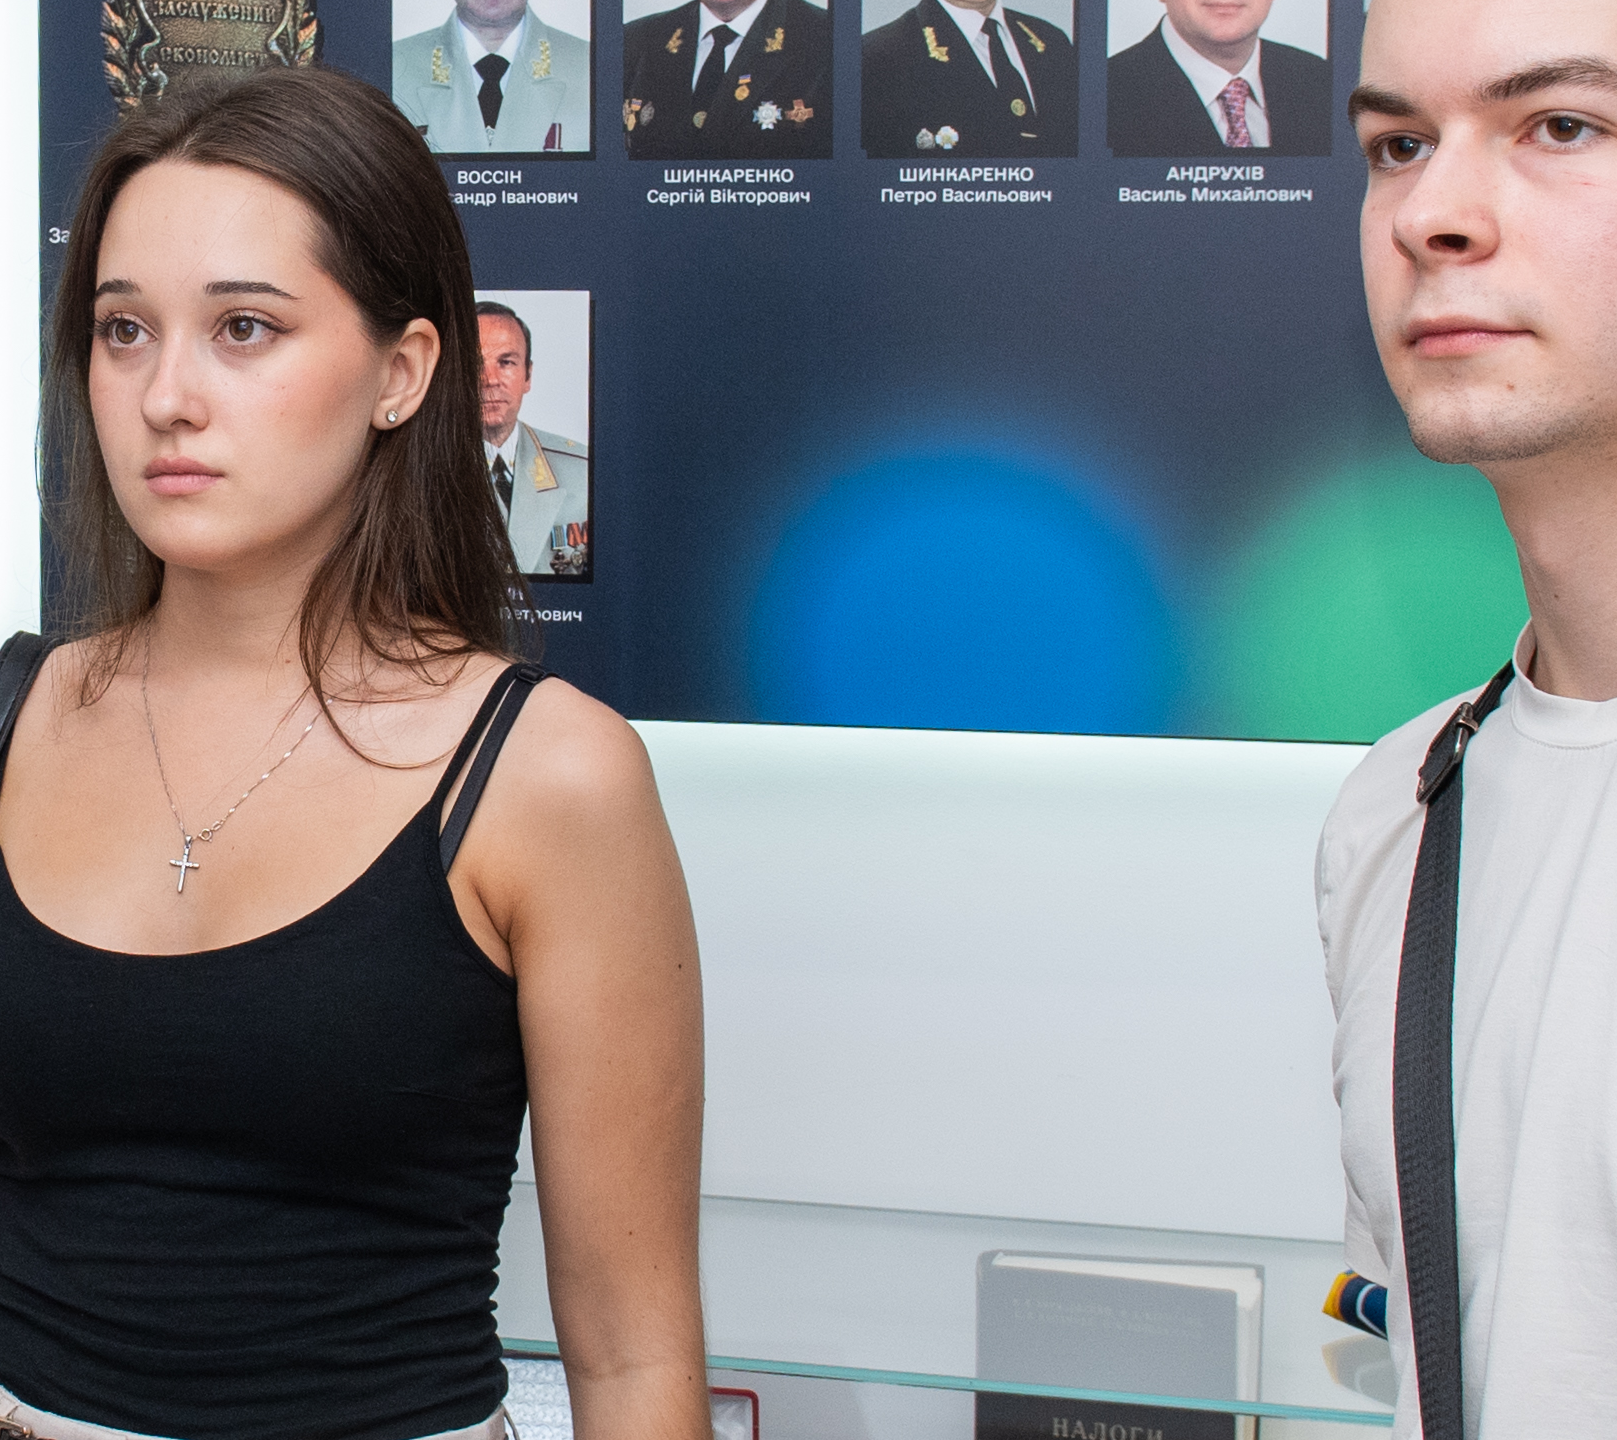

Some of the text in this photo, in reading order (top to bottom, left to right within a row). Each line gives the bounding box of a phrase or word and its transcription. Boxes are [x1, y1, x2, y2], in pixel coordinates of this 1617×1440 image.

[458, 170, 521, 184] ВОССІН
[664, 169, 794, 183] ШИНКАРЕНКО
[900, 167, 1034, 182] ШИНКАРЕНКО
[1166, 166, 1264, 183] АНДРУХІВ
[502, 190, 578, 205] Іванович
[647, 188, 810, 206] Сергій Вікторович
[881, 187, 1052, 205] Петро Васильович
[1119, 187, 1312, 202] Василь Михайлович
